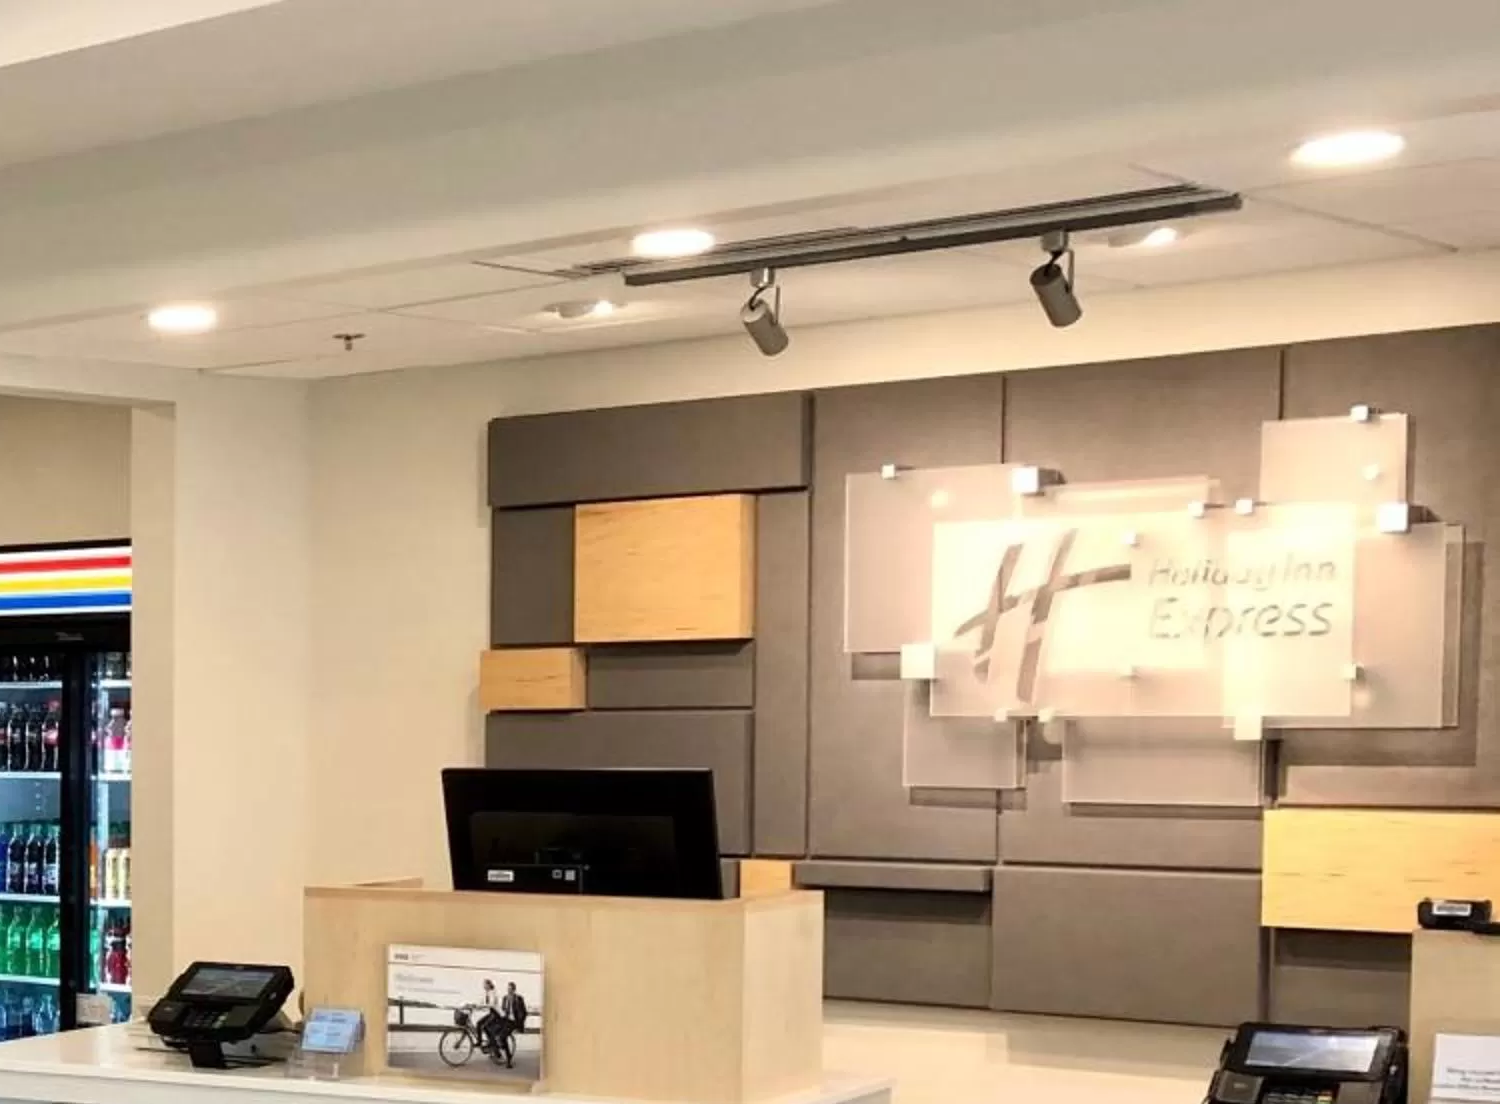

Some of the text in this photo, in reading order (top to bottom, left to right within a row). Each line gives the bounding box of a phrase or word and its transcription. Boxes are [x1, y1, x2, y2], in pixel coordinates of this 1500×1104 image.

[1148, 552, 1337, 592] Holiday Inn
[1149, 596, 1334, 645] Express
